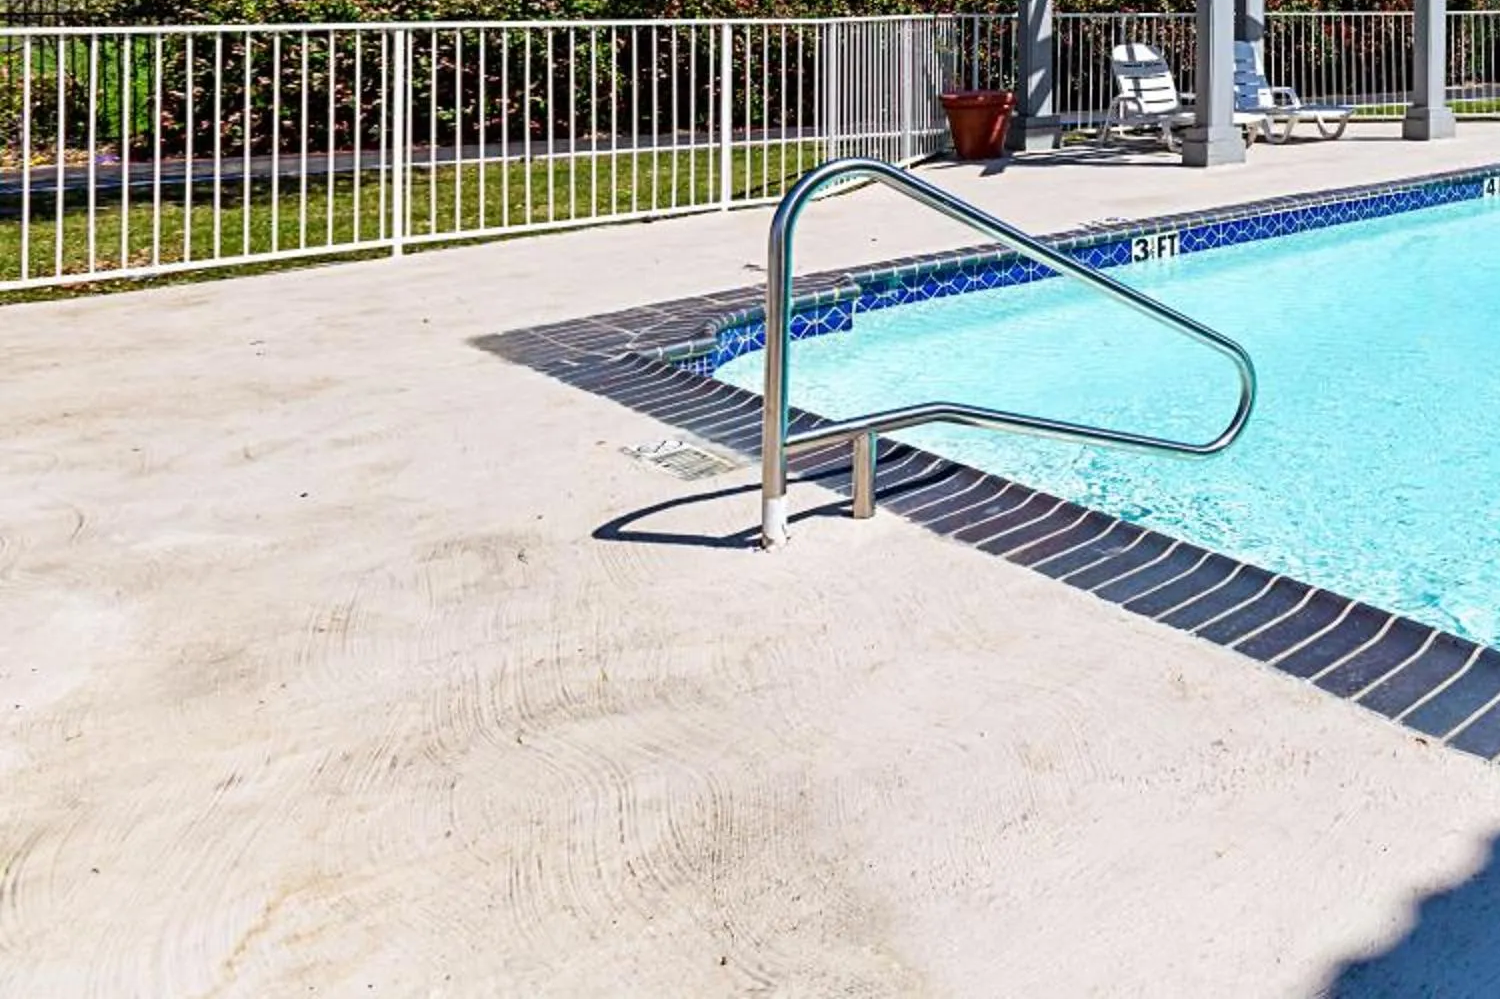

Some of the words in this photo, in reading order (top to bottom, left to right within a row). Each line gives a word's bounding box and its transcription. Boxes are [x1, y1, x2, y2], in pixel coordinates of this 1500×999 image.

[1486, 178, 1496, 196] 4
[1134, 238, 1149, 261] 3
[1157, 233, 1177, 258] FT
